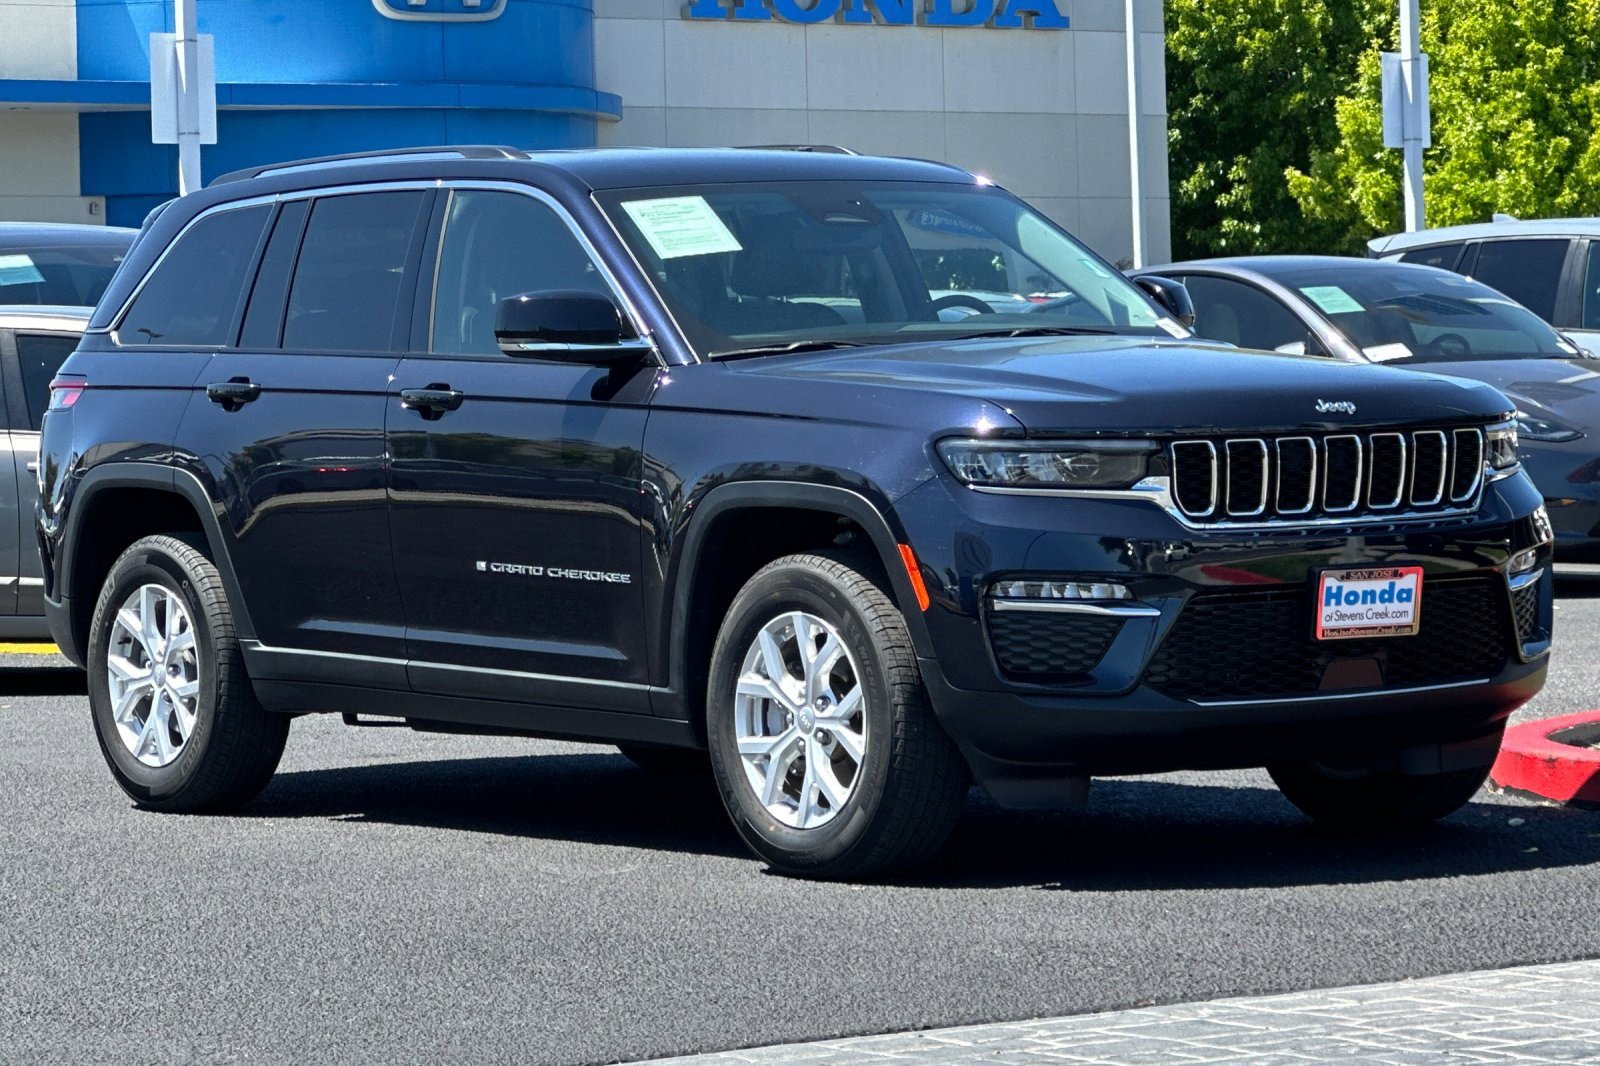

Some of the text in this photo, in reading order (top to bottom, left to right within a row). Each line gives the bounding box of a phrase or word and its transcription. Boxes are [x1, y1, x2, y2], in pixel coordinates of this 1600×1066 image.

[1315, 398, 1357, 415] Jeep
[490, 562, 631, 584] GRAND CHEROKEE
[1349, 570, 1393, 579] SAN JOSE
[1324, 581, 1413, 607] Honda
[1324, 606, 1409, 622] of Stevens Creek.com
